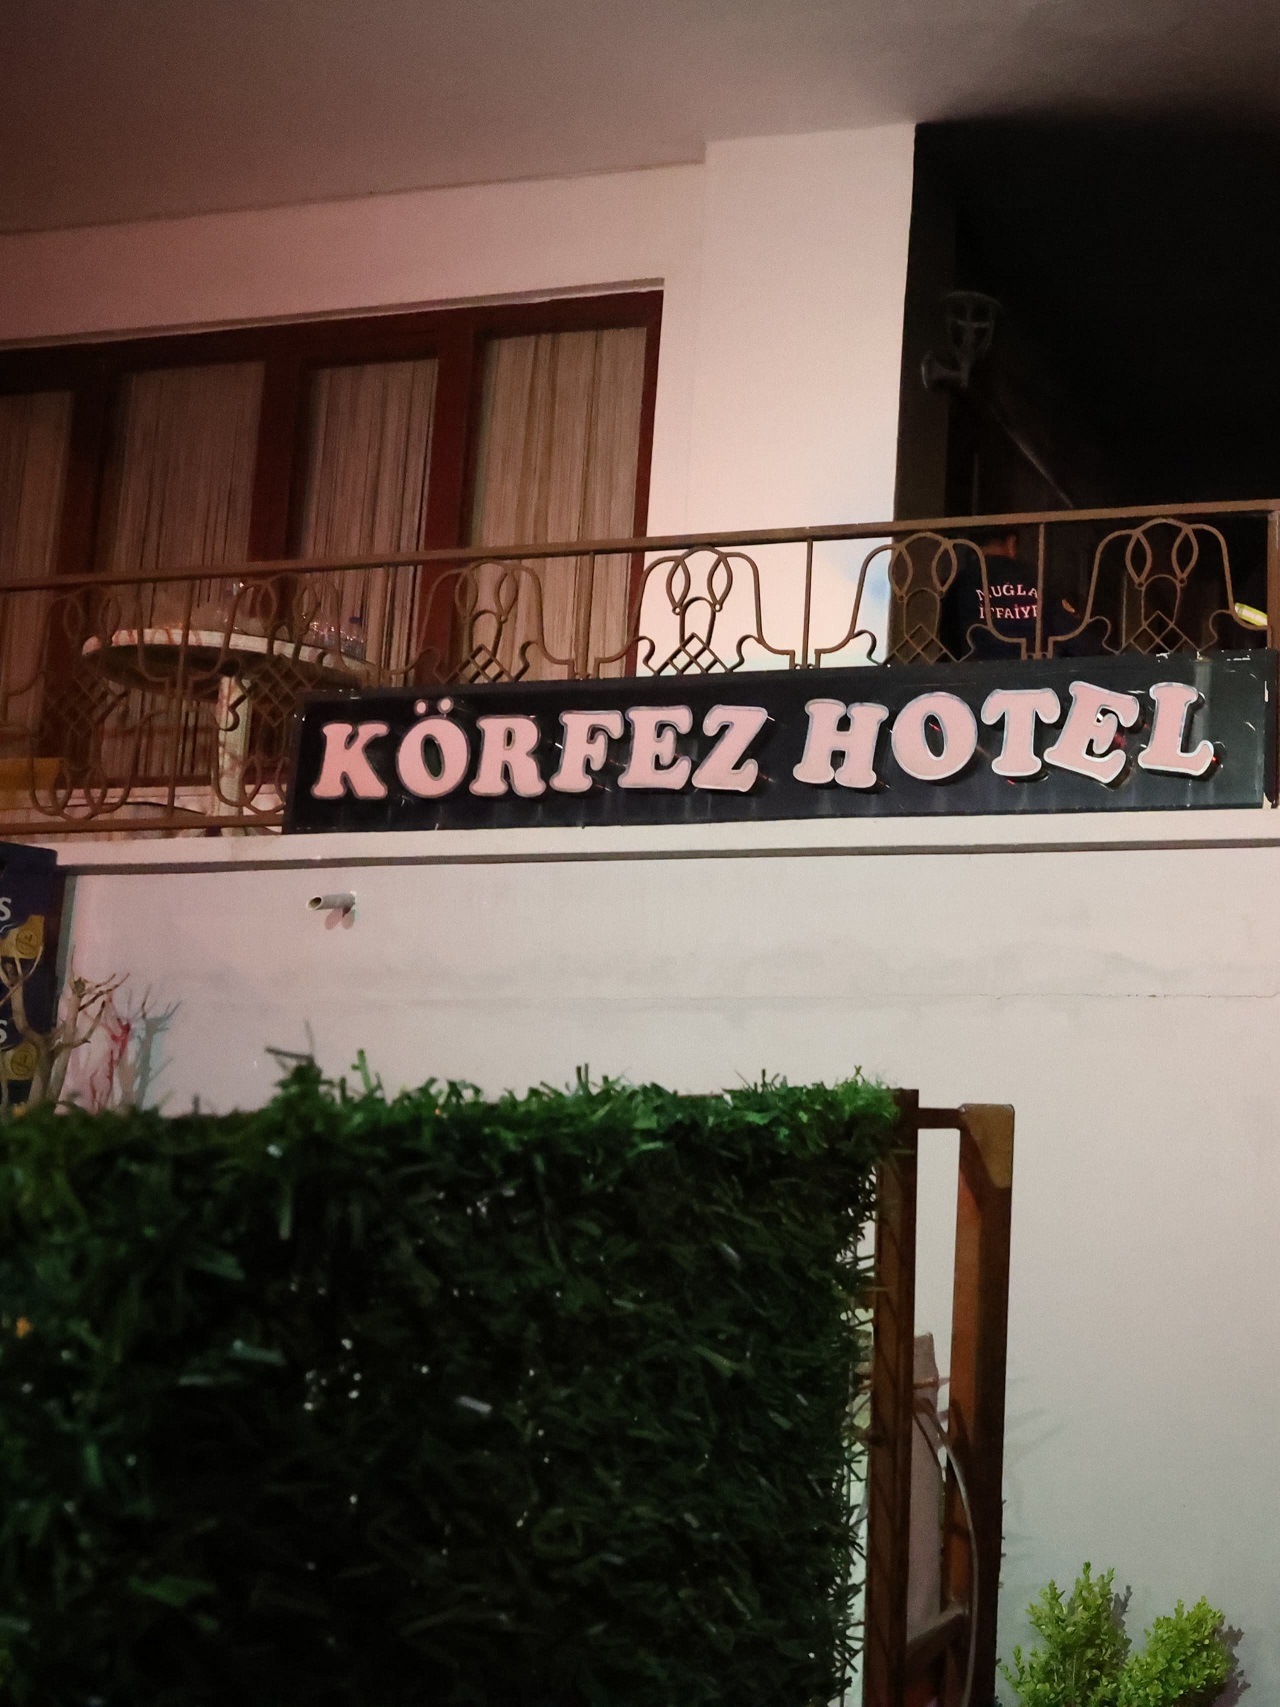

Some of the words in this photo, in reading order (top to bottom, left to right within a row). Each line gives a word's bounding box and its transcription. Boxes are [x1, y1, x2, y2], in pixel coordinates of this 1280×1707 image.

[979, 603, 1038, 619] İFAİY
[311, 697, 768, 799] KÖRFEZ
[792, 681, 1215, 789] HOTEL
